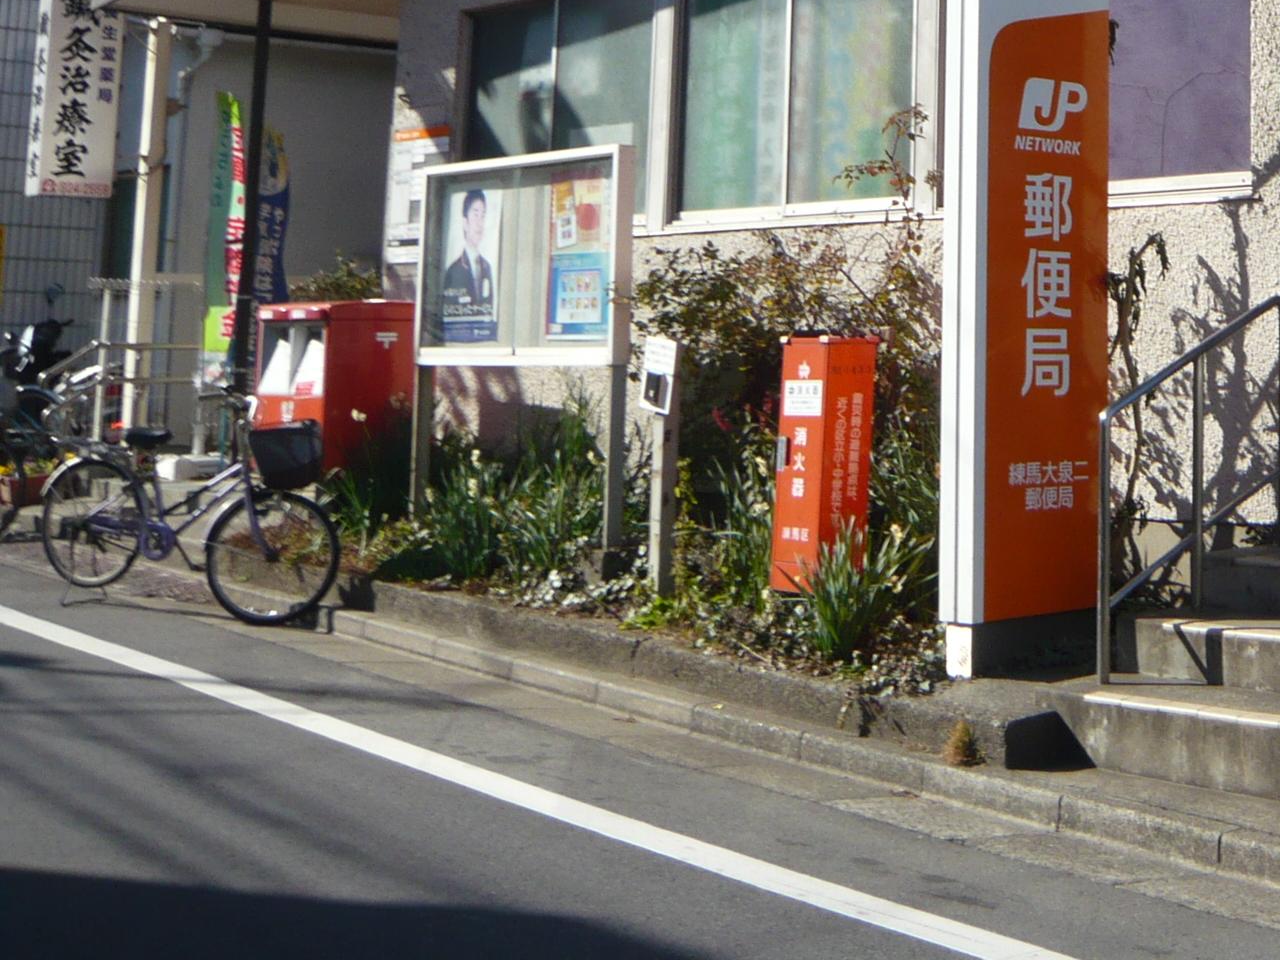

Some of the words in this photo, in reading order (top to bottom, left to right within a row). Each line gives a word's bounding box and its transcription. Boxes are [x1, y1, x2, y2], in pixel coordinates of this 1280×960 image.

[1018, 77, 1088, 132] JP
[1014, 134, 1081, 157] NETWORK
[1021, 172, 1073, 398] 郵便局
[791, 426, 808, 498] 消火器
[1008, 460, 1090, 486] 練馬大泉二
[1025, 486, 1074, 511] 郵便局
